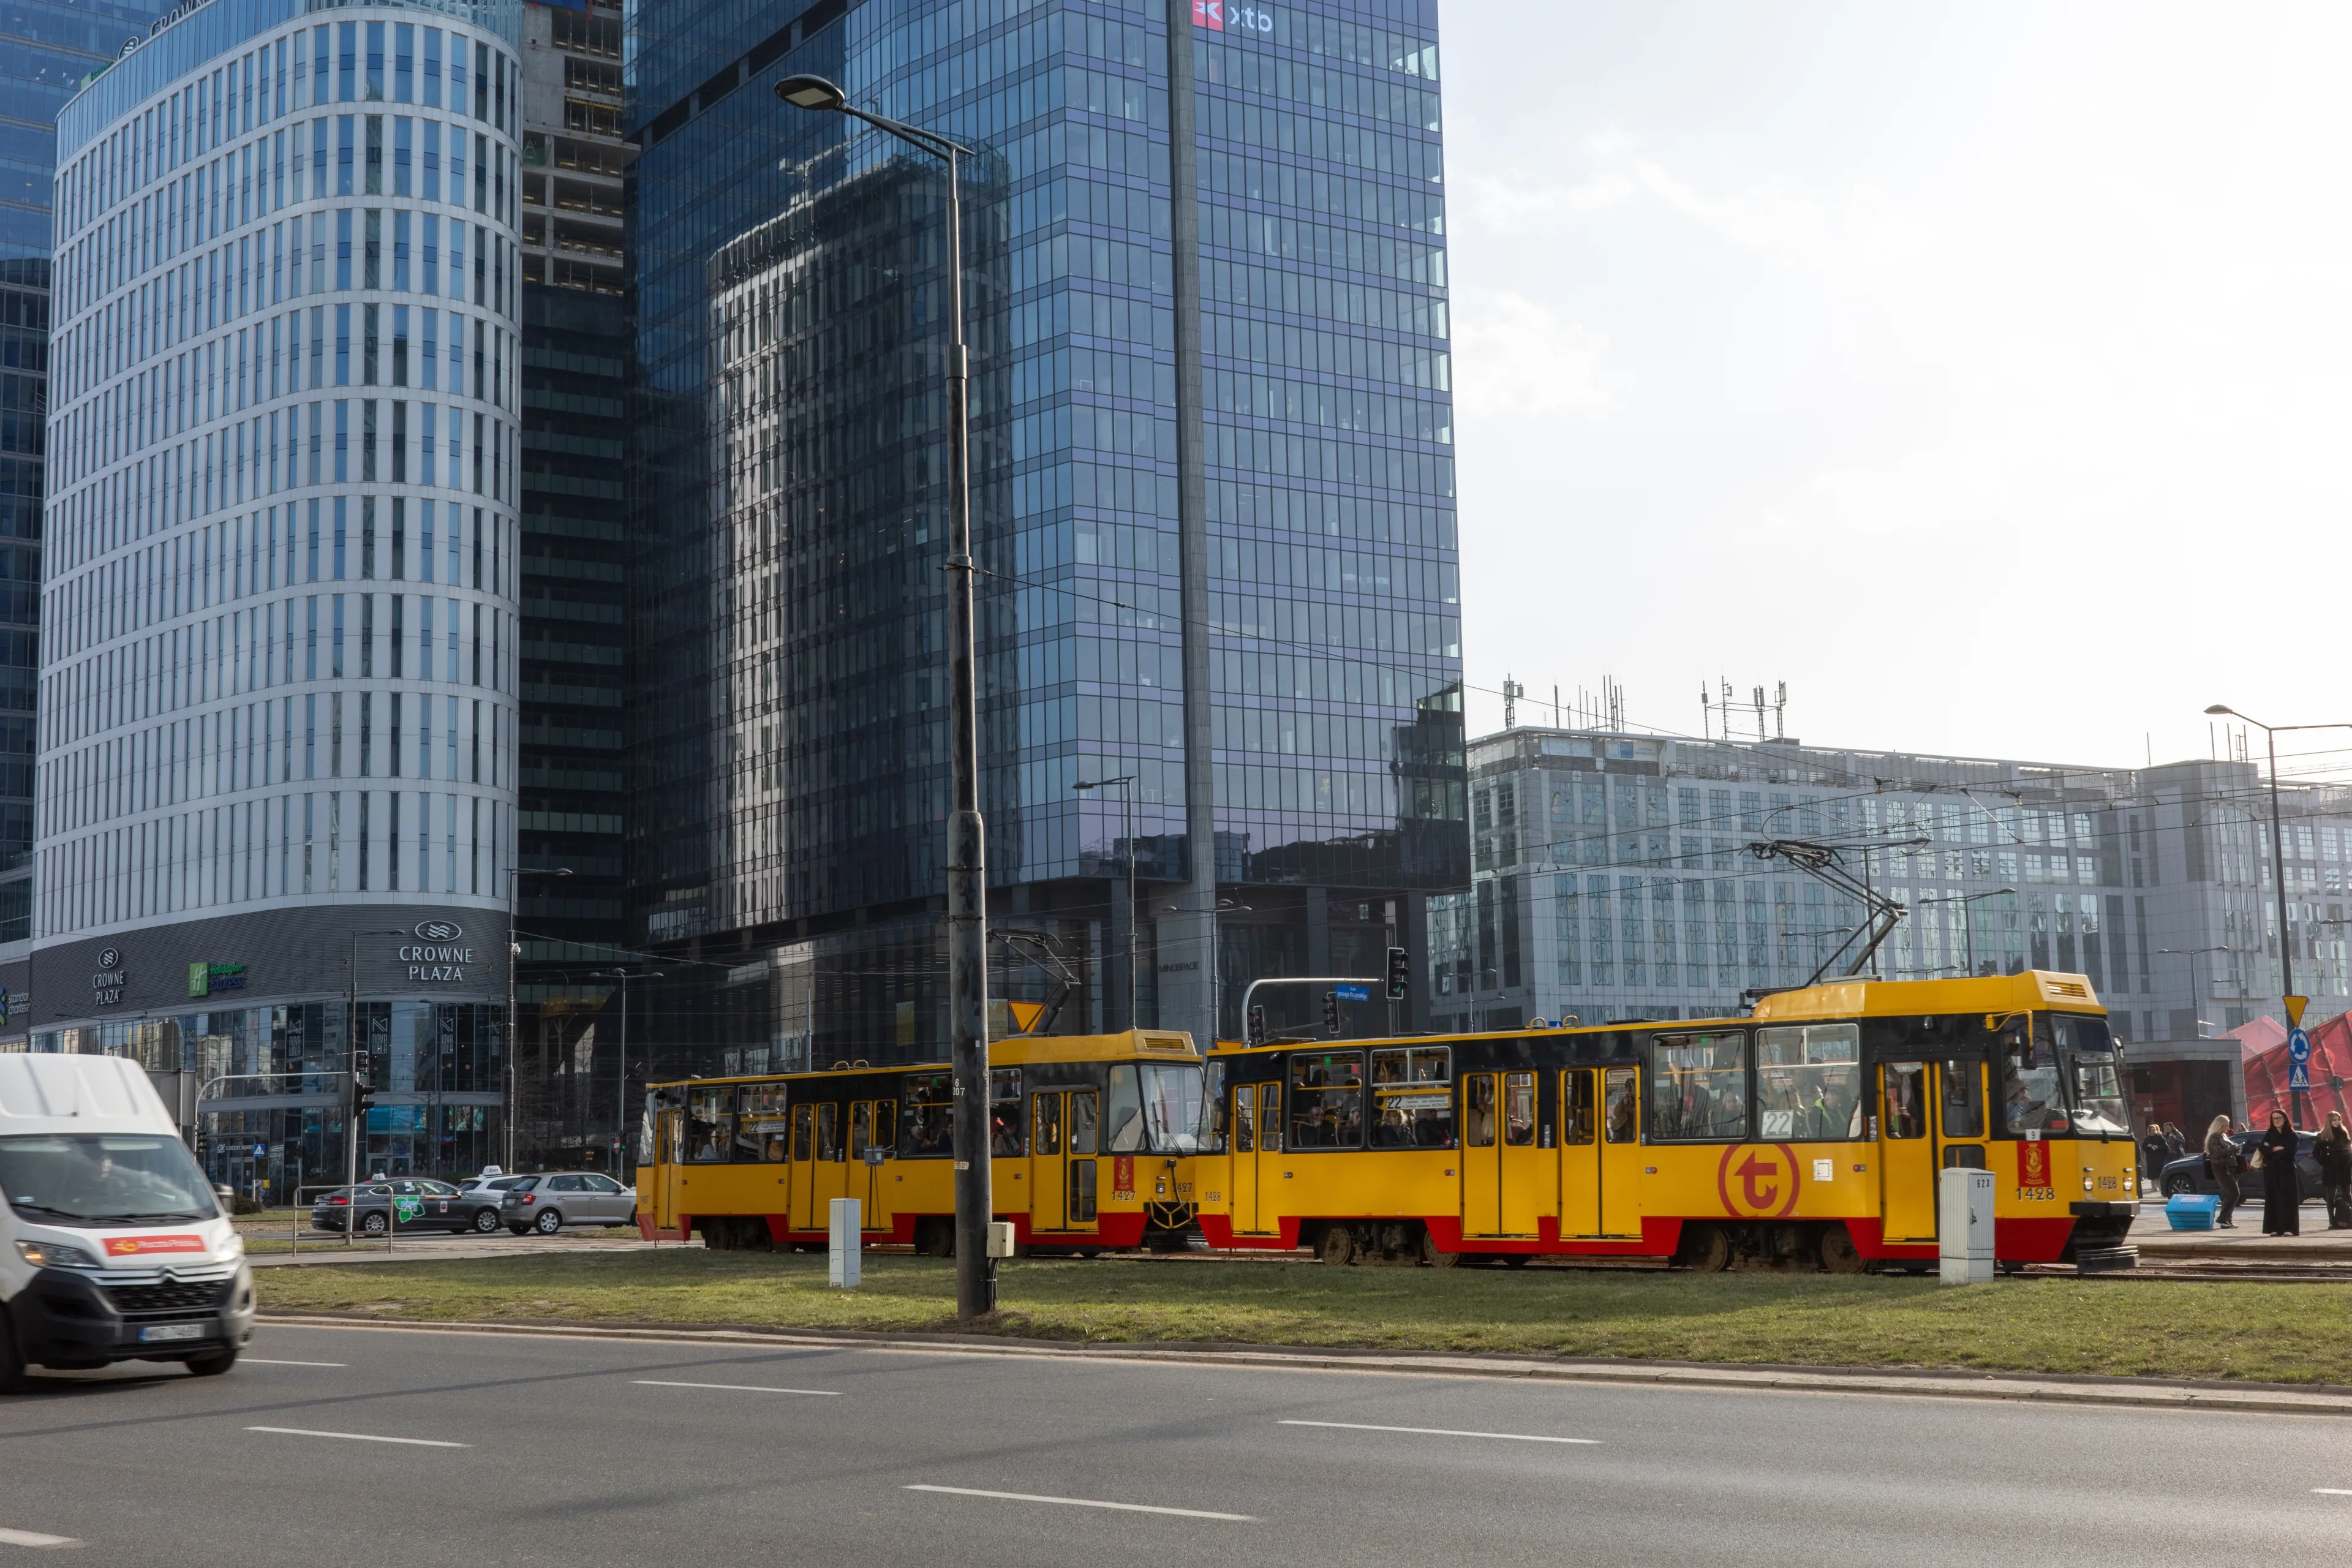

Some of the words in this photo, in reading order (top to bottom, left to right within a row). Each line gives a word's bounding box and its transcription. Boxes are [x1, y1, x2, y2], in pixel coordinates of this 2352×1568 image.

[1229, 7, 1272, 32] xtb
[399, 946, 472, 963] CROWNE
[92, 970, 124, 988] CROWNE
[409, 966, 463, 981] PLAZA
[211, 976, 243, 989] Express
[96, 989, 119, 1005] PLAZA
[288, 1036, 301, 1046] NOVA
[371, 1034, 387, 1044] NOVA
[955, 1079, 960, 1087] 6
[953, 1087, 965, 1096] 207
[1387, 1096, 1401, 1109] 22
[749, 1121, 759, 1133] 22
[1765, 1112, 1790, 1135] 22
[2030, 1131, 2036, 1139] 9
[1977, 1178, 1990, 1188] 623
[2097, 1176, 2117, 1191] 1428
[1111, 1191, 1136, 1202] 1427
[1204, 1191, 1221, 1202] 1428
[2016, 1187, 2056, 1201] 1428
